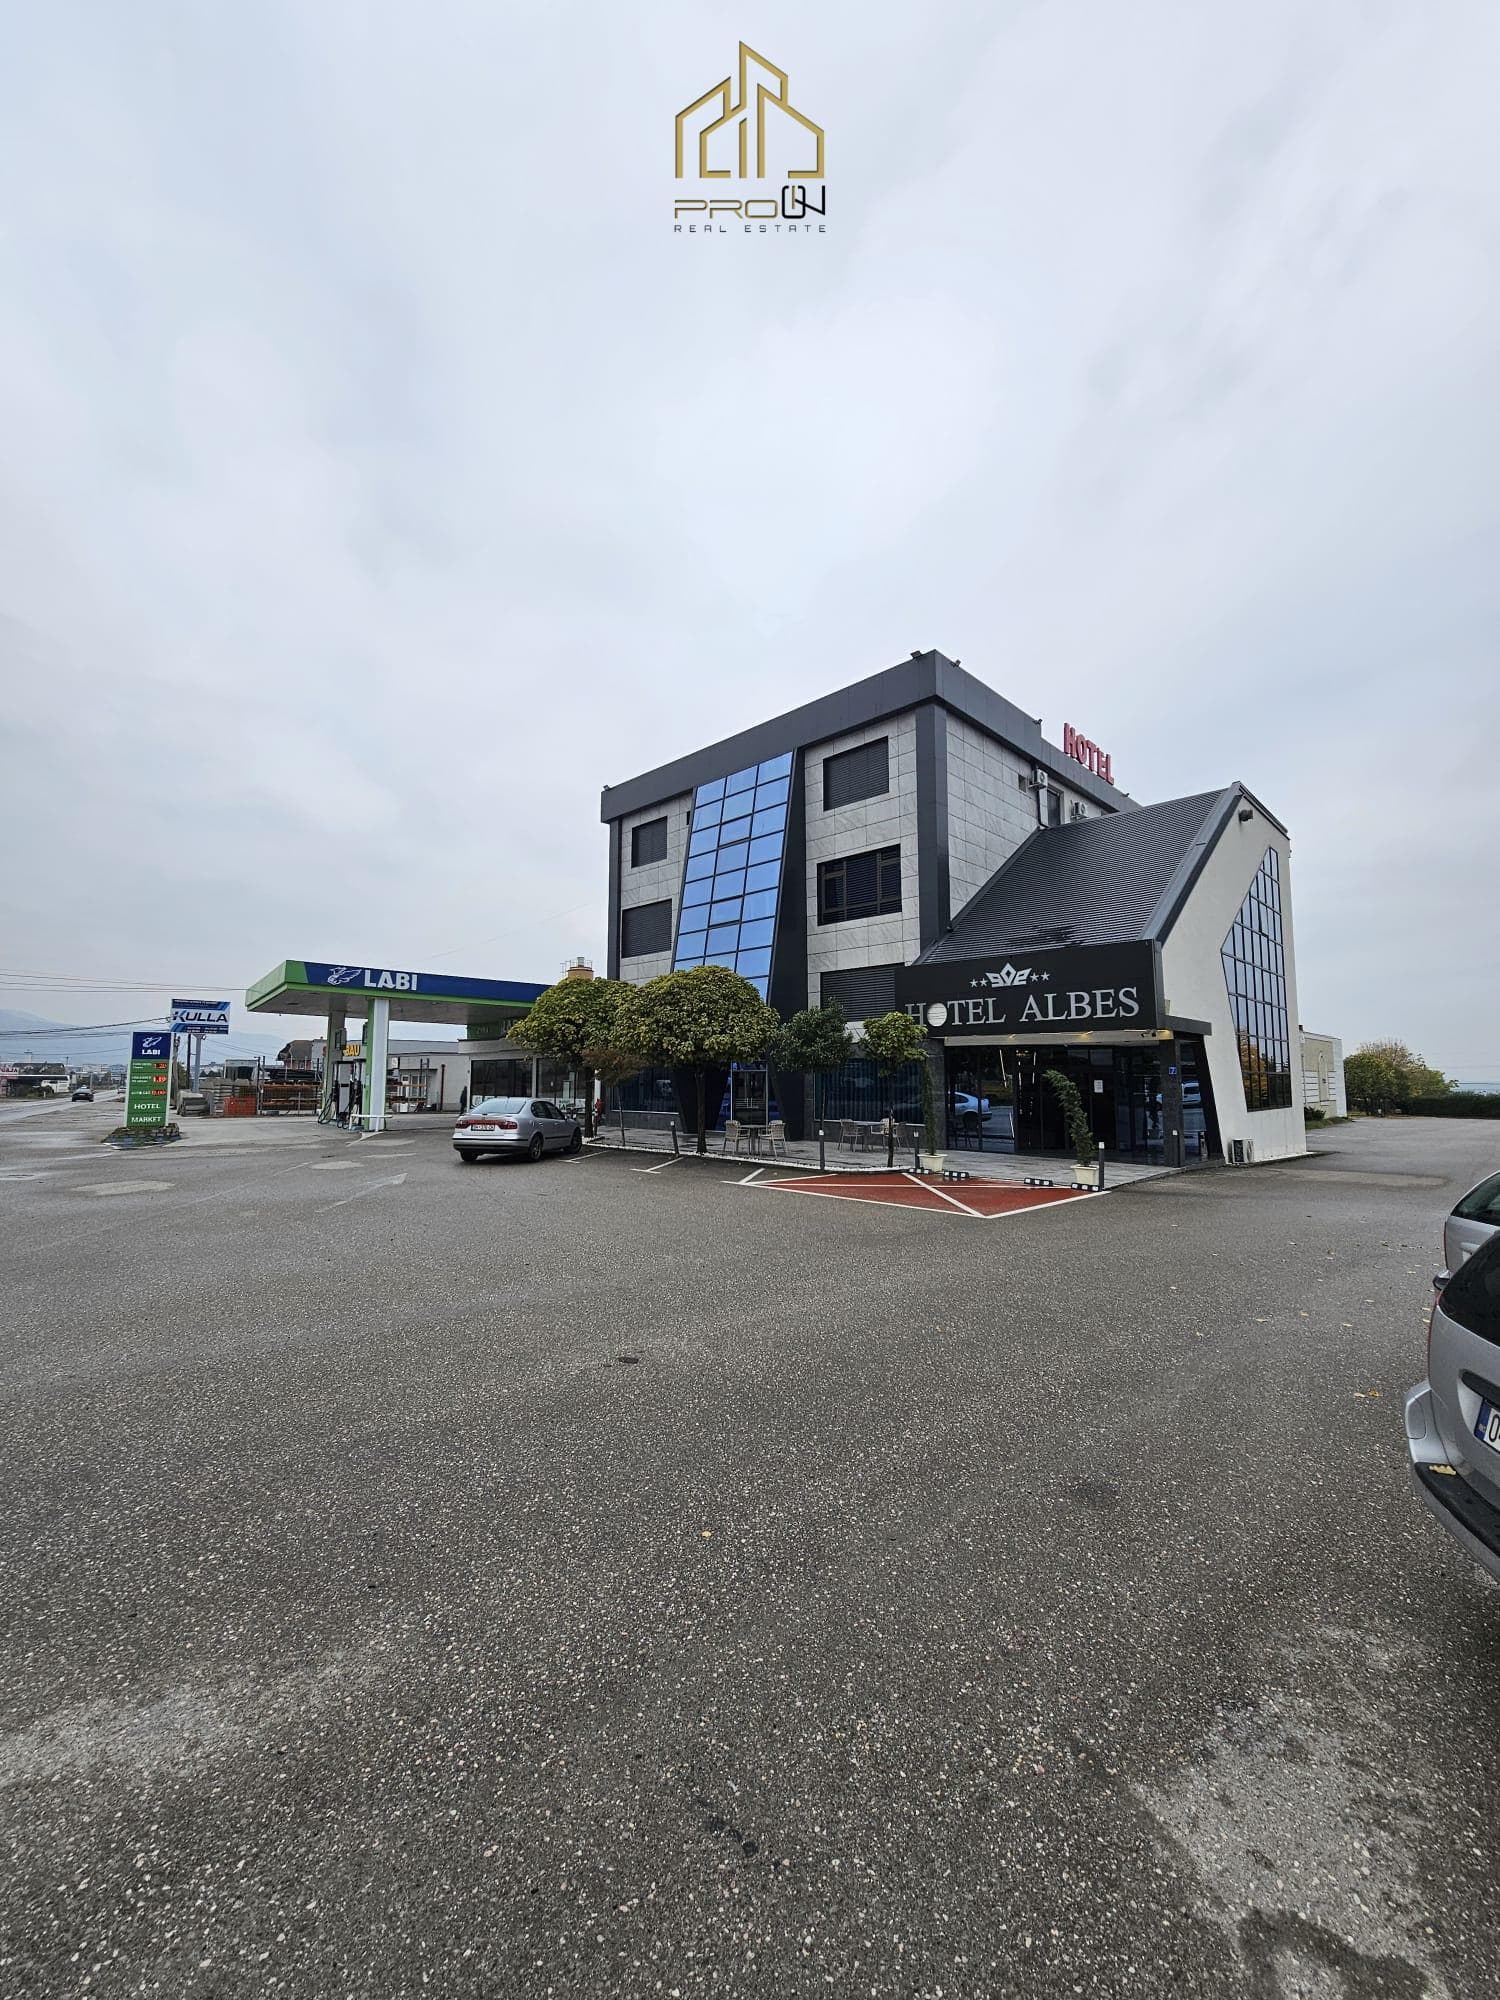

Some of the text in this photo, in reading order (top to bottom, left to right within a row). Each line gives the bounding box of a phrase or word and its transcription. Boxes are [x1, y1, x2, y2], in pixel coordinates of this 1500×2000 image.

[1063, 722, 1115, 786] HOTEL
[364, 969, 418, 991] LABI
[172, 1010, 228, 1023] KULLA
[904, 987, 1140, 1027] HOTEL ALBES
[1489, 1414, 1500, 1443] 0
